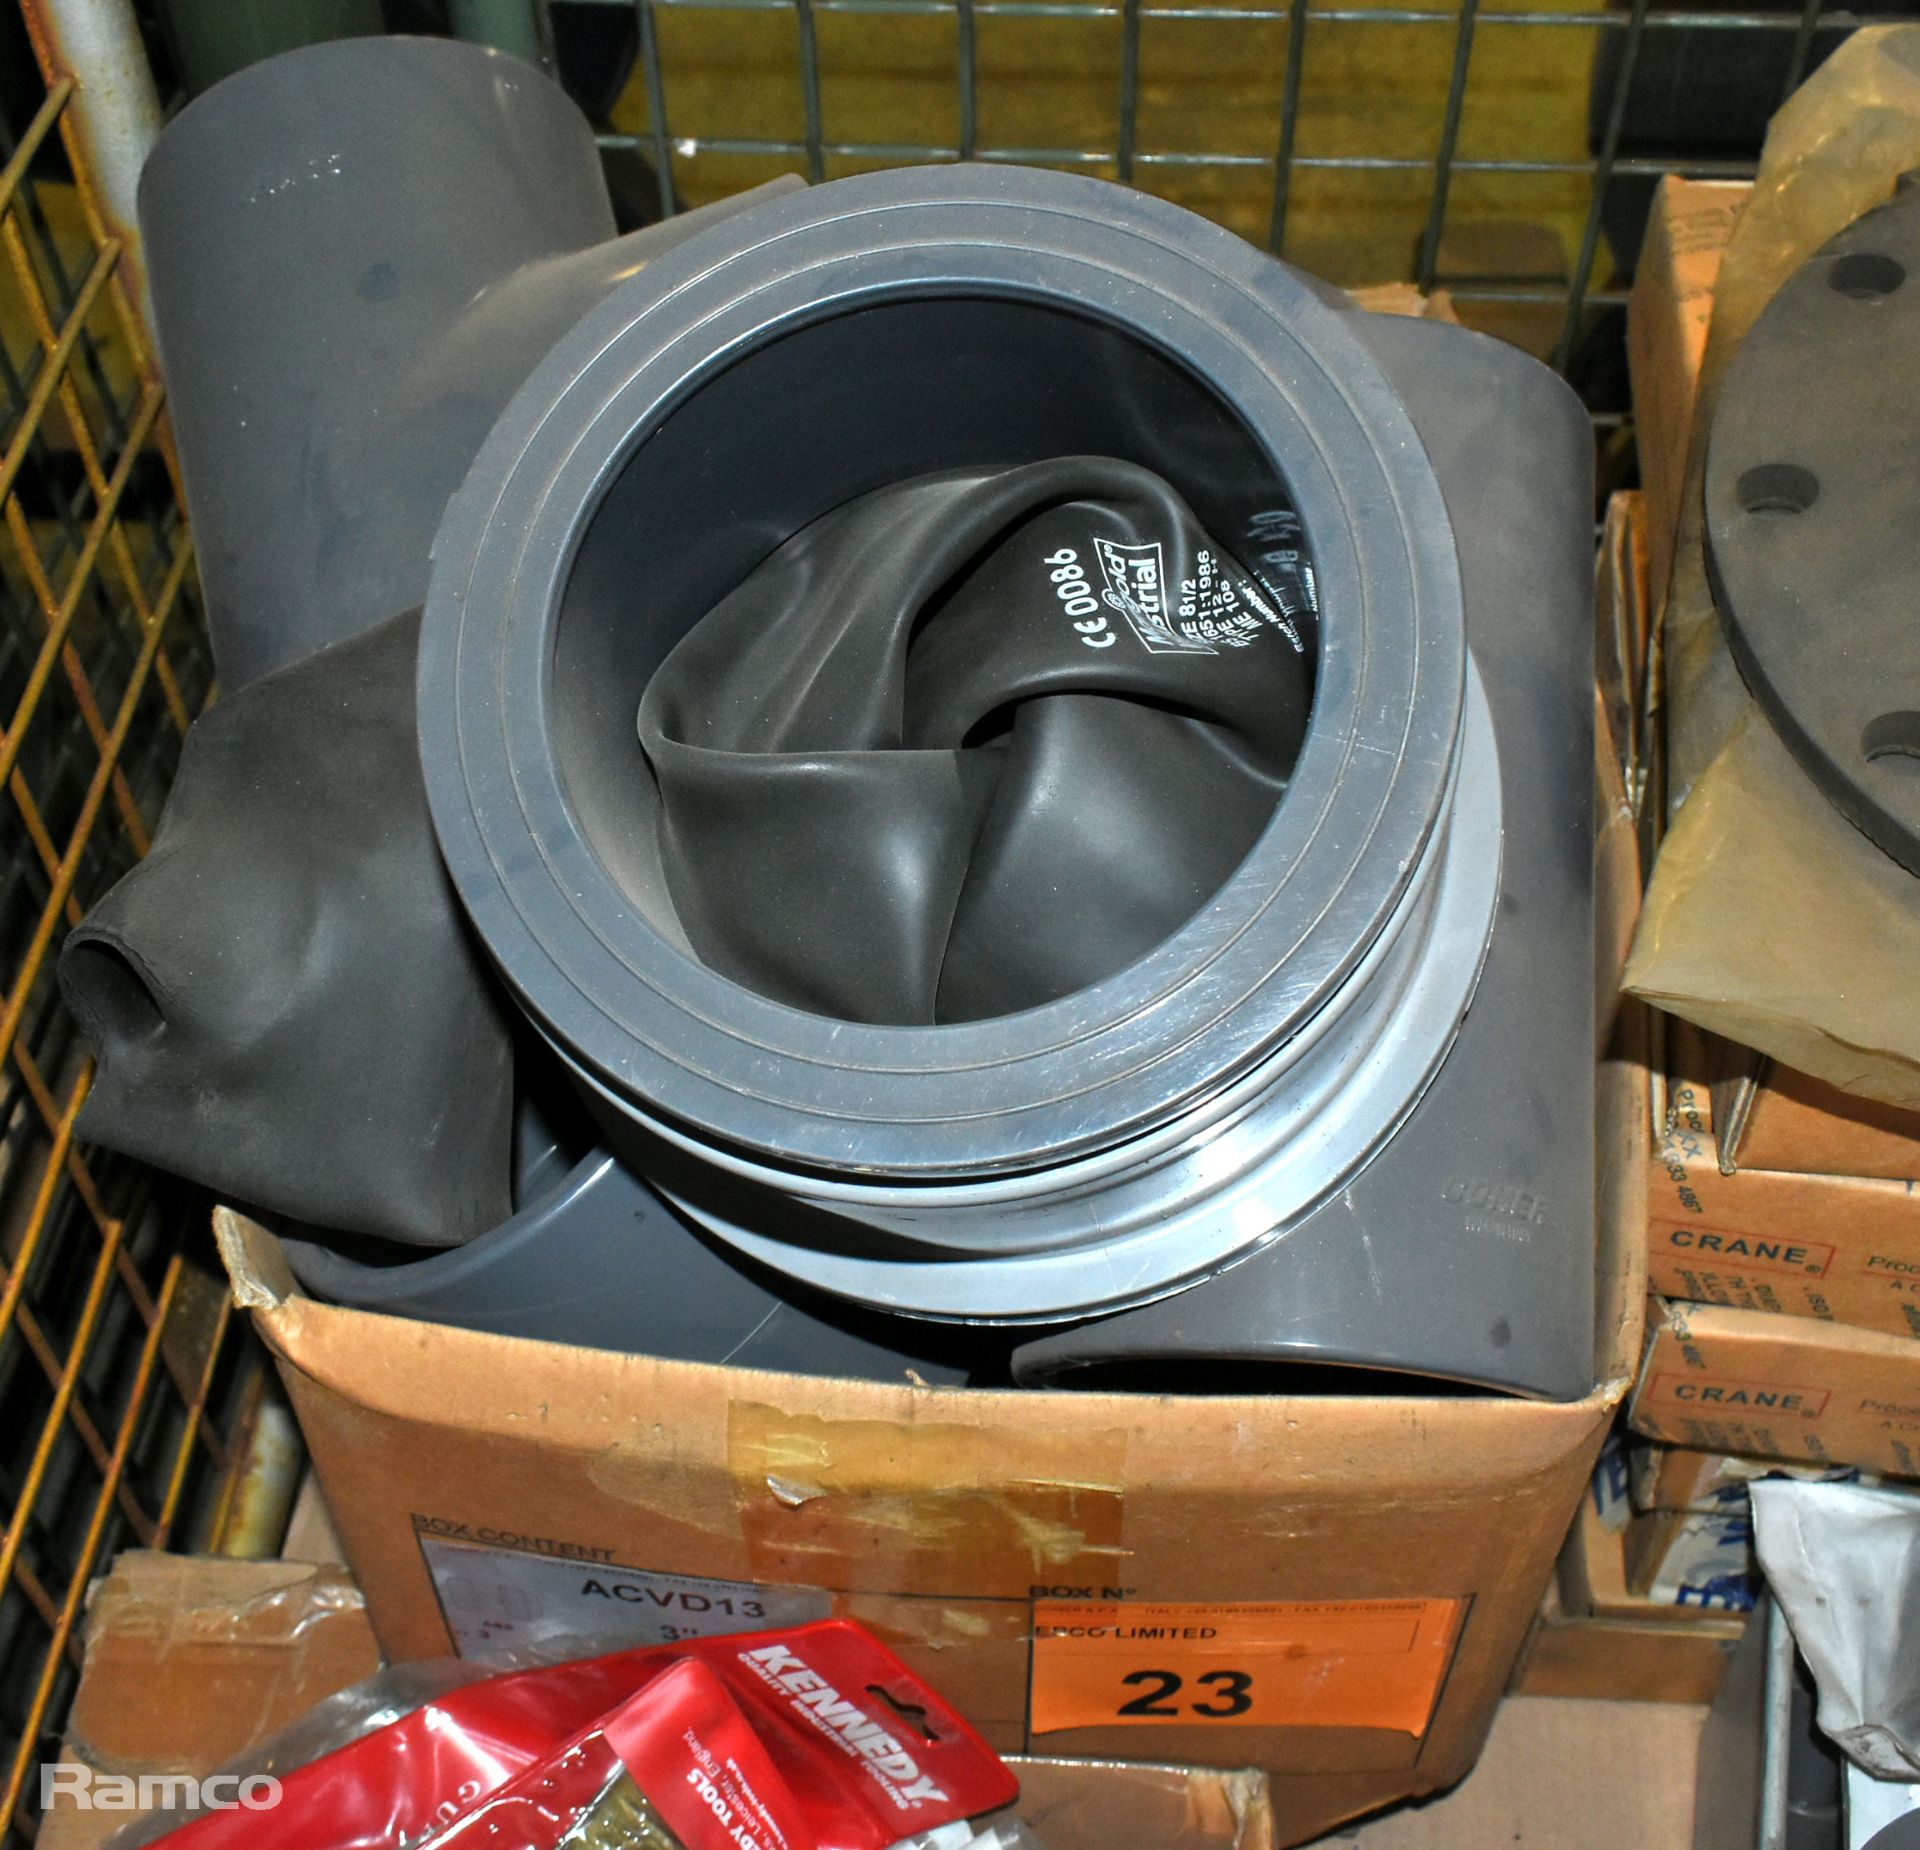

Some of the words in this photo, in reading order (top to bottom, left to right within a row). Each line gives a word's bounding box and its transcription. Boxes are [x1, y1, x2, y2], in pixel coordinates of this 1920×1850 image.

[1044, 548, 1099, 616] 0086
[1220, 580, 1240, 613] 108
[1670, 1231, 1808, 1263] CRANE
[1675, 1385, 1803, 1408] CRANE
[413, 1514, 468, 1537] BOX
[478, 1527, 616, 1562] CONTENT
[581, 1579, 766, 1619] ACVD13
[1029, 1585, 1092, 1599] BOX
[1115, 1626, 1217, 1640] LIMITED
[1117, 1670, 1254, 1718] 23
[749, 1645, 949, 1802] KENNEDY
[686, 1767, 734, 1828] TOOLS
